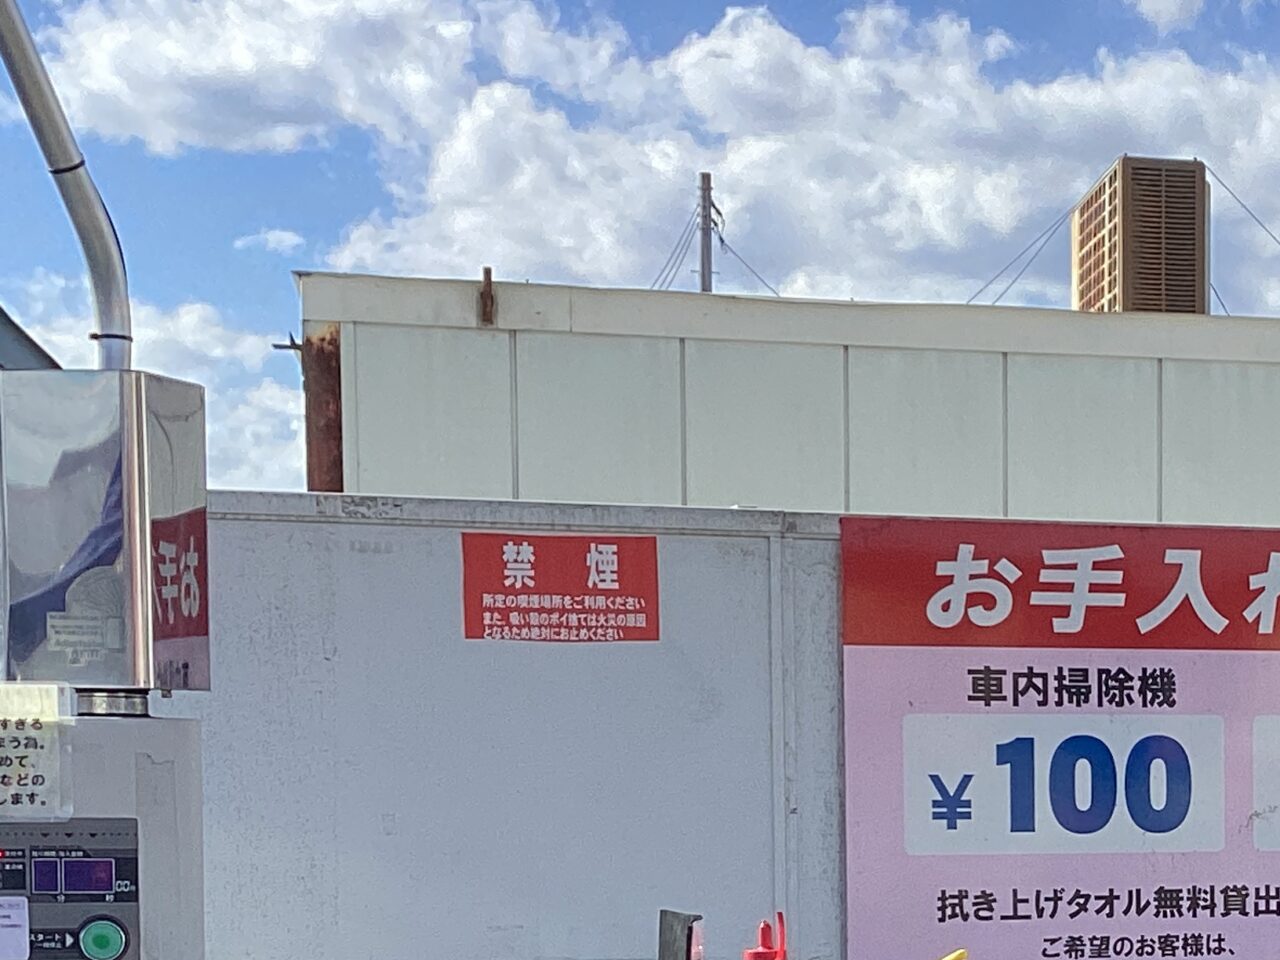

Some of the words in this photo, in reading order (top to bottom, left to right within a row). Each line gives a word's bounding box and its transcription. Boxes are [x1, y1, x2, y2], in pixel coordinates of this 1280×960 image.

[502, 541, 620, 590] 禁煙
[482, 593, 646, 610] 所定の喫煙場所をご利用ください
[483, 626, 624, 641] となるため絶対にお止めください
[966, 665, 1177, 708] 車内掃除機
[1041, 932, 1237, 960] ご希望のお客様は、
